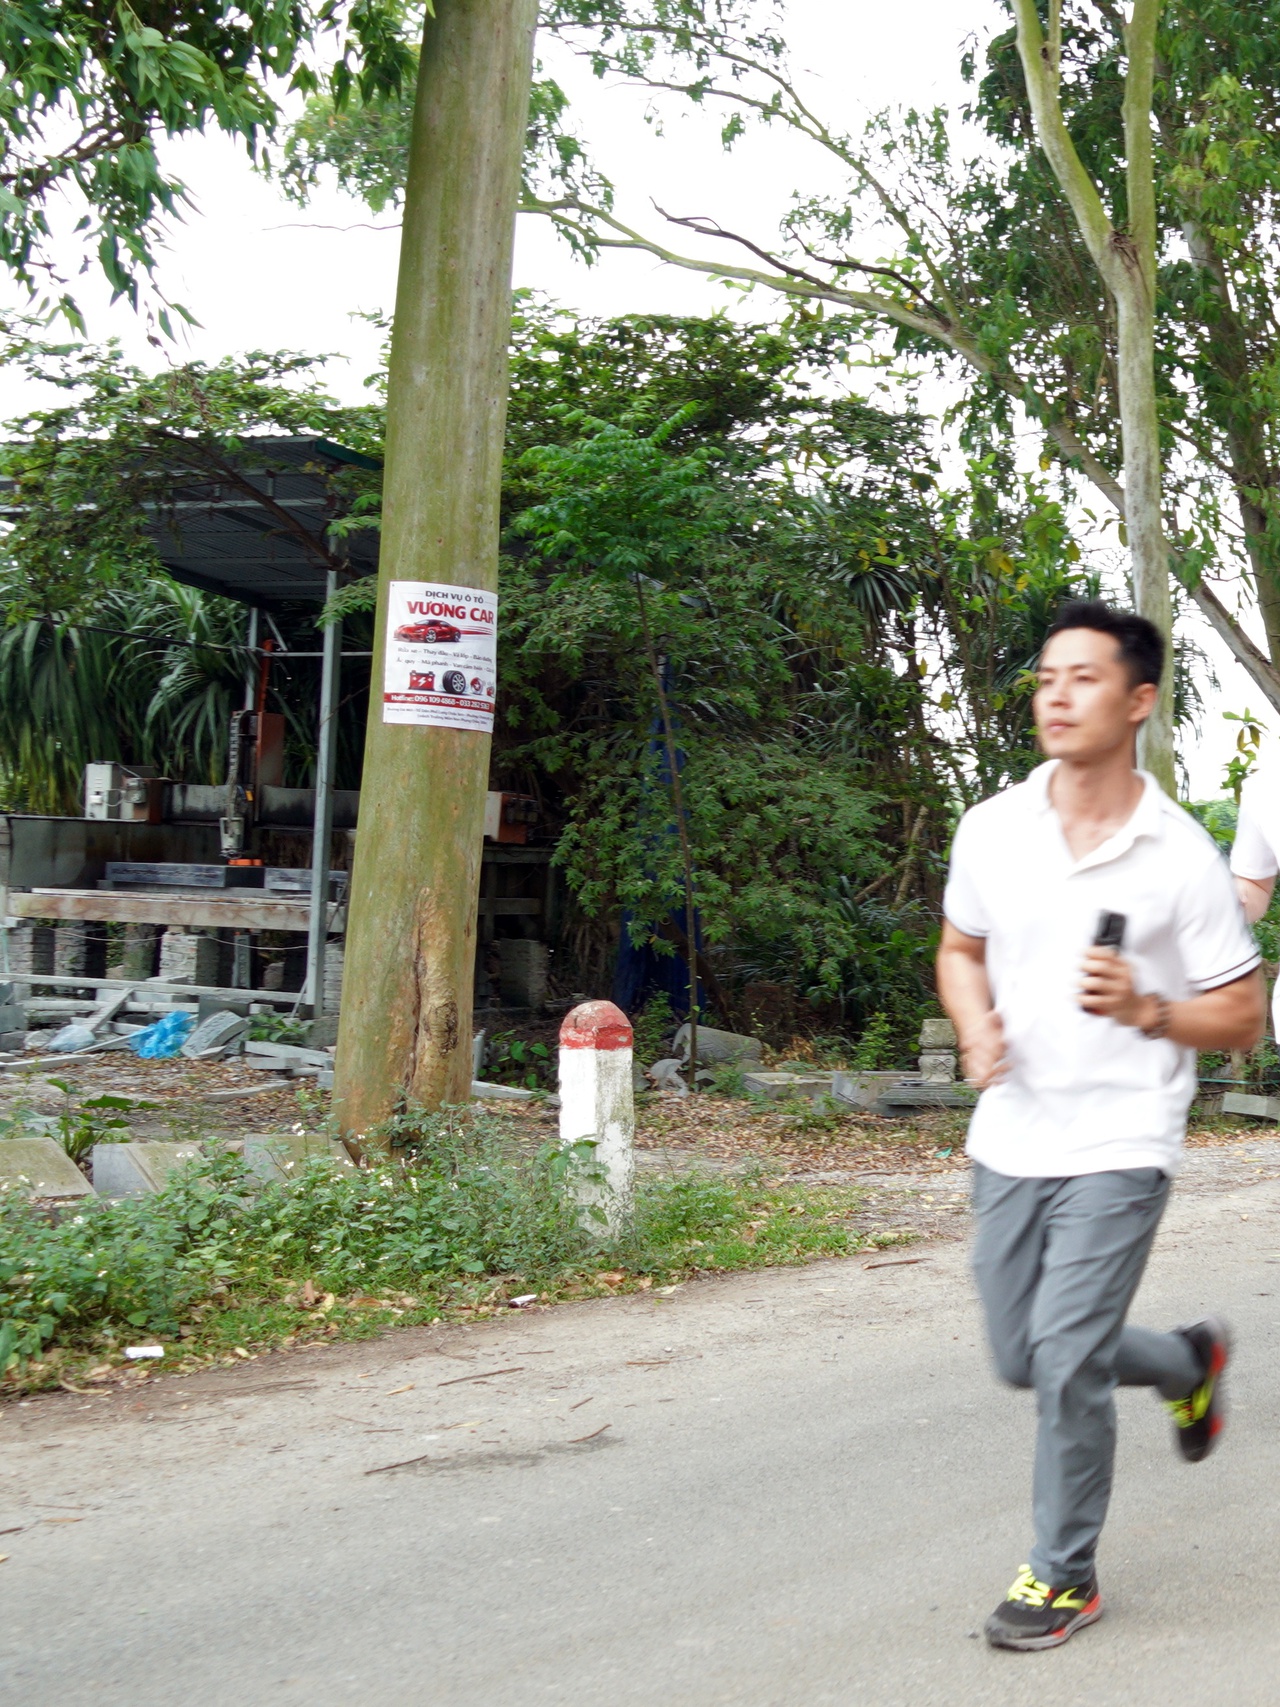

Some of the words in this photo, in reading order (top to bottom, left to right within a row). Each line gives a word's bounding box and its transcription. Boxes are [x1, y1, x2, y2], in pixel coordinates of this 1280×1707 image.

[426, 590, 448, 600] DỊCH
[450, 593, 462, 602] VỤ
[473, 596, 484, 604] TÔ
[406, 600, 466, 620] VƯƠNG
[470, 608, 494, 624] CAR
